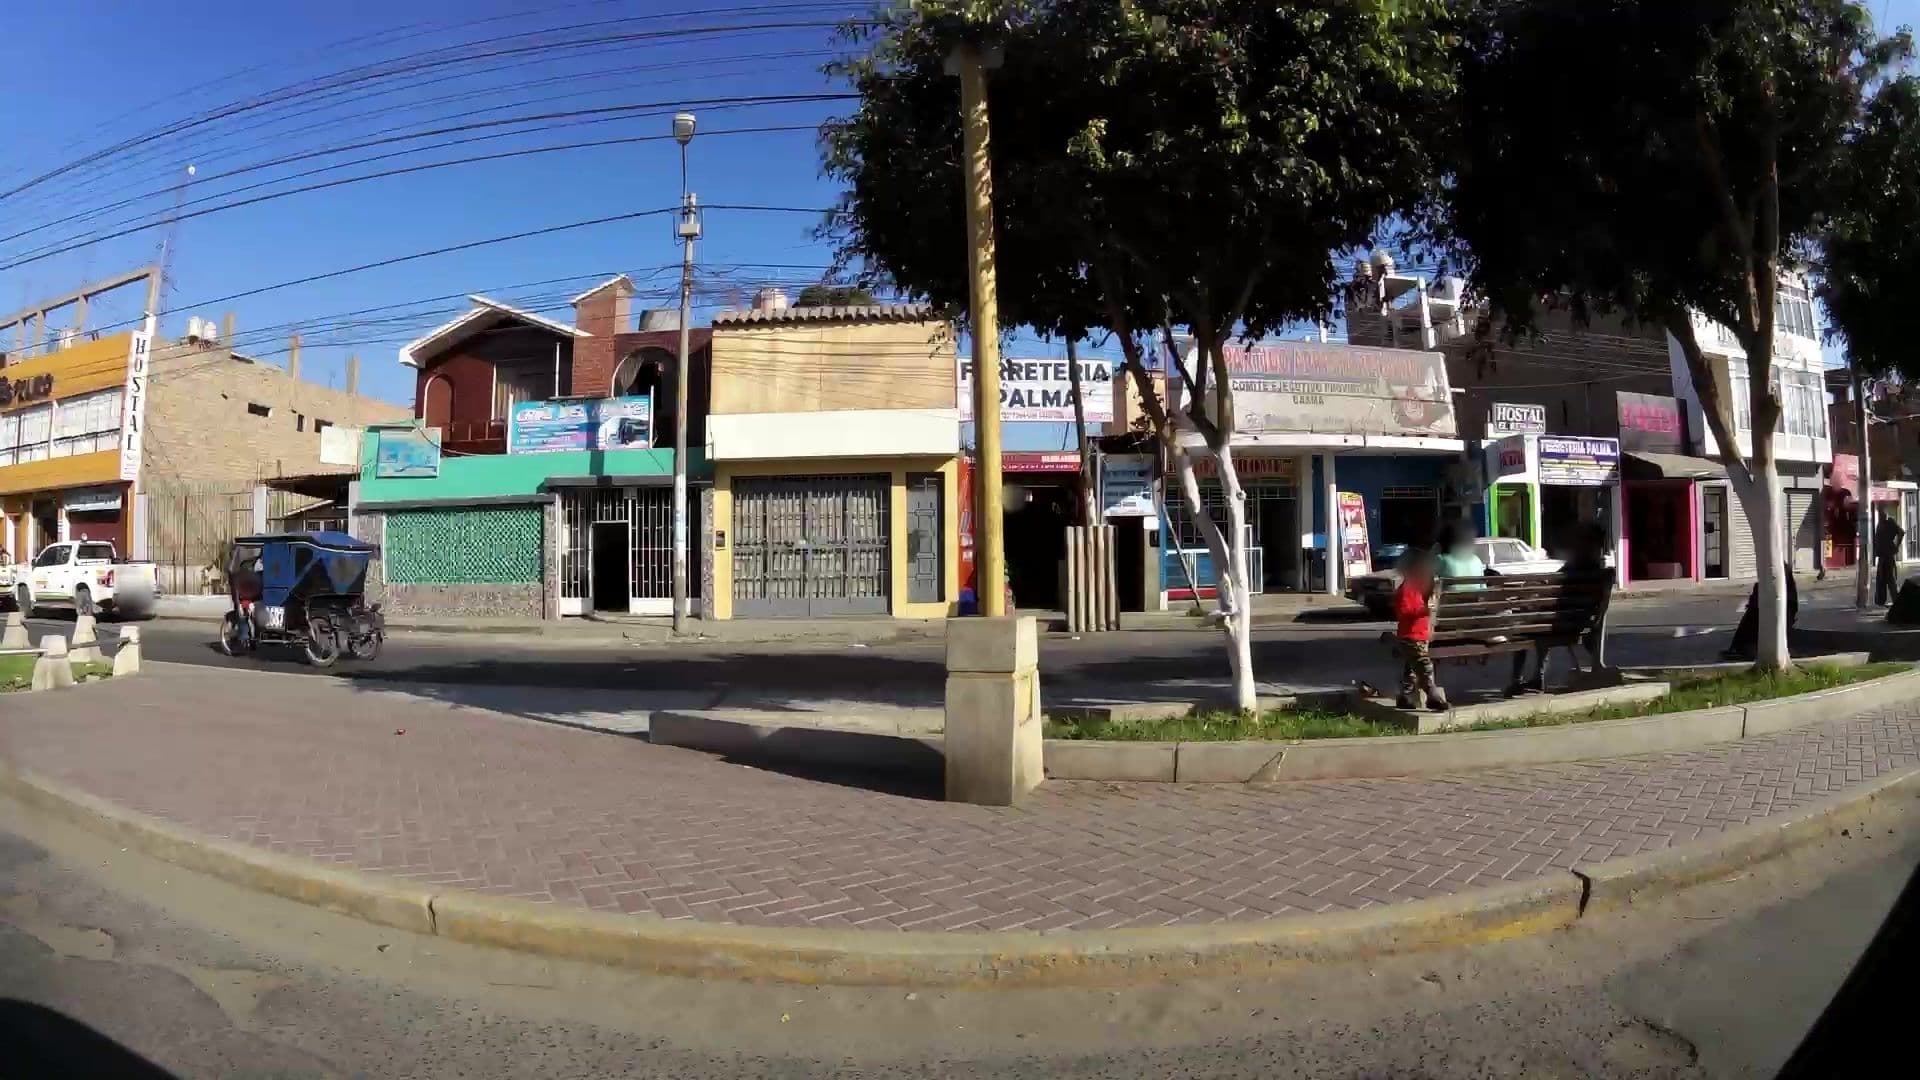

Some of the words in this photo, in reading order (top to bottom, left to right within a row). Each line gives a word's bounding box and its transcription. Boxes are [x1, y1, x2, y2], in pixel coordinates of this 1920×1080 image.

[960, 362, 1110, 382] FRRETERIA
[127, 336, 147, 451] HOSTAL
[1496, 406, 1544, 423] HOSTAL
